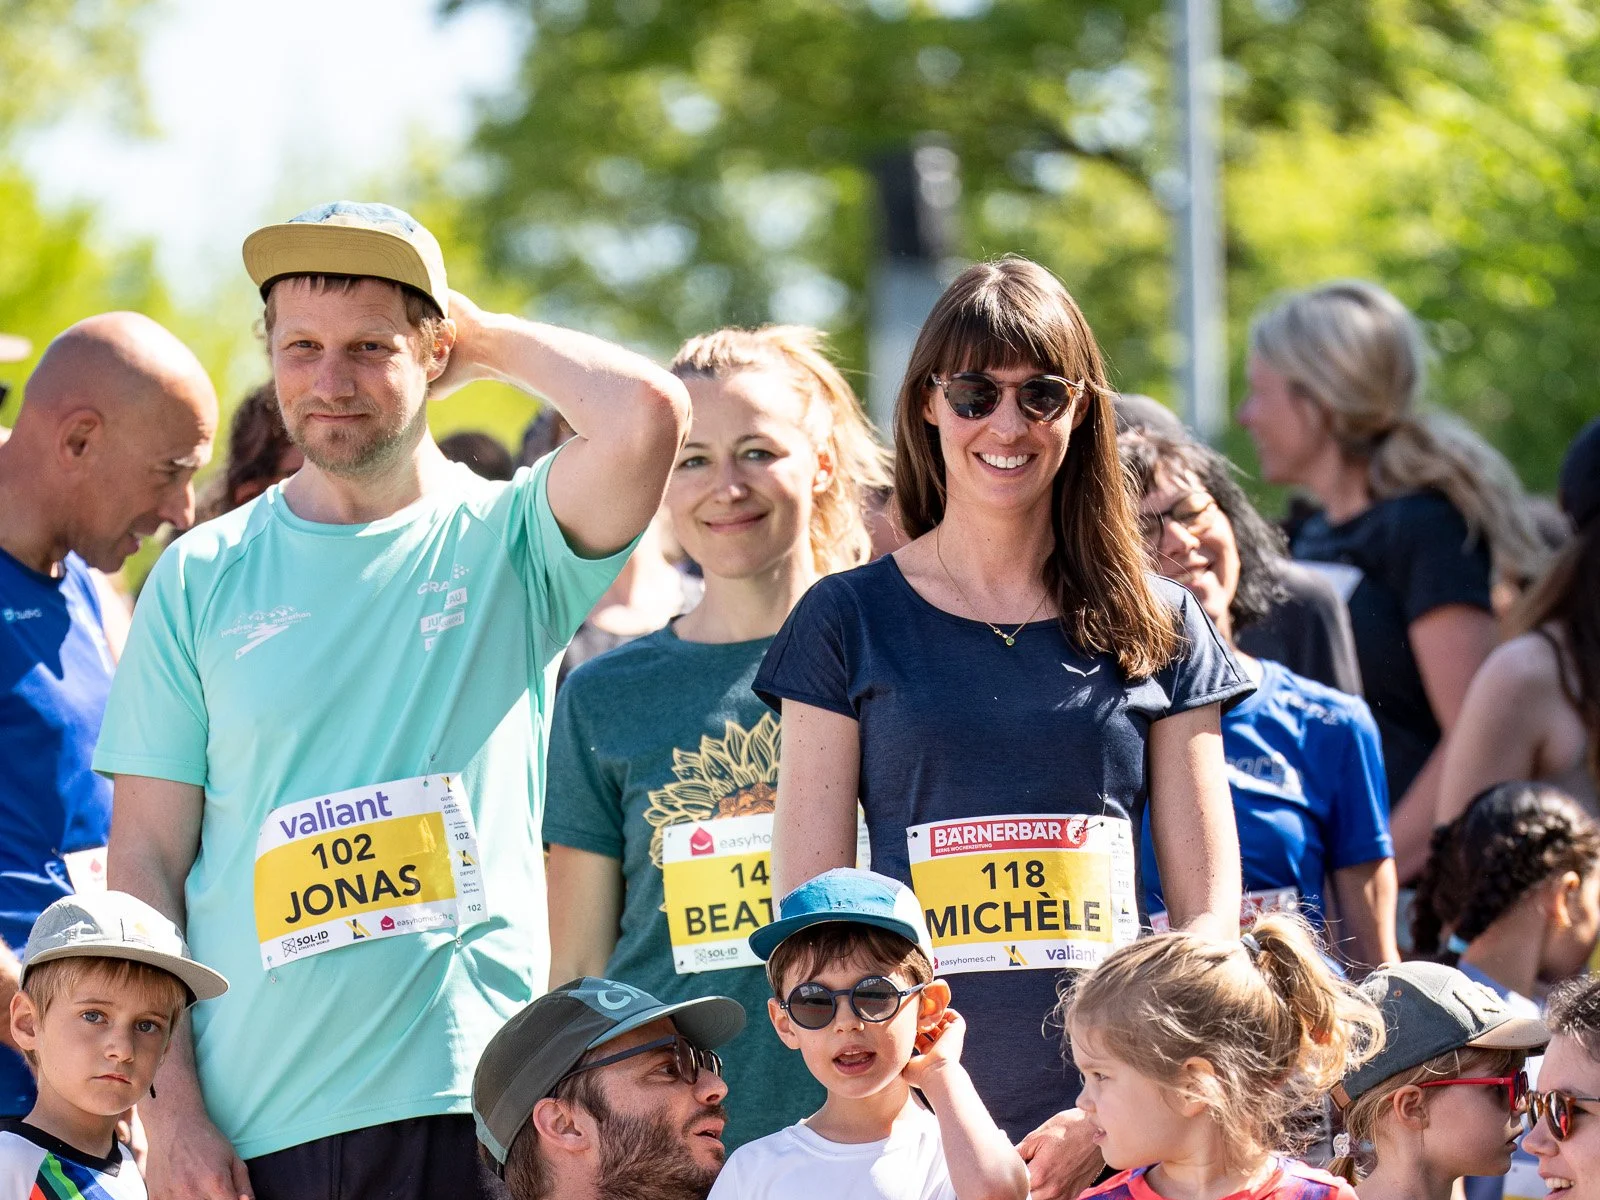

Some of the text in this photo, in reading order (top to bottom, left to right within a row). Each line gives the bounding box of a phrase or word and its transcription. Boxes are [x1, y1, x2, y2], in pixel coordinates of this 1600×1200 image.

[417, 580, 450, 595] CRA
[279, 791, 392, 840] valiant
[454, 831, 470, 841] 102
[719, 831, 772, 849] easyho
[934, 821, 1062, 848] BÄRNERBÄR
[311, 833, 376, 870] 102
[459, 869, 476, 877] DEPOT
[730, 860, 770, 888] 14
[981, 860, 1046, 890] 118
[285, 864, 422, 924] JONAS
[467, 903, 482, 912] 102
[685, 897, 774, 936] BEAT
[926, 892, 1101, 940] MICHÈLE
[396, 913, 448, 927] easyhomes.ch
[940, 955, 996, 968] easyhomes.ch
[1046, 945, 1097, 962] valiant
